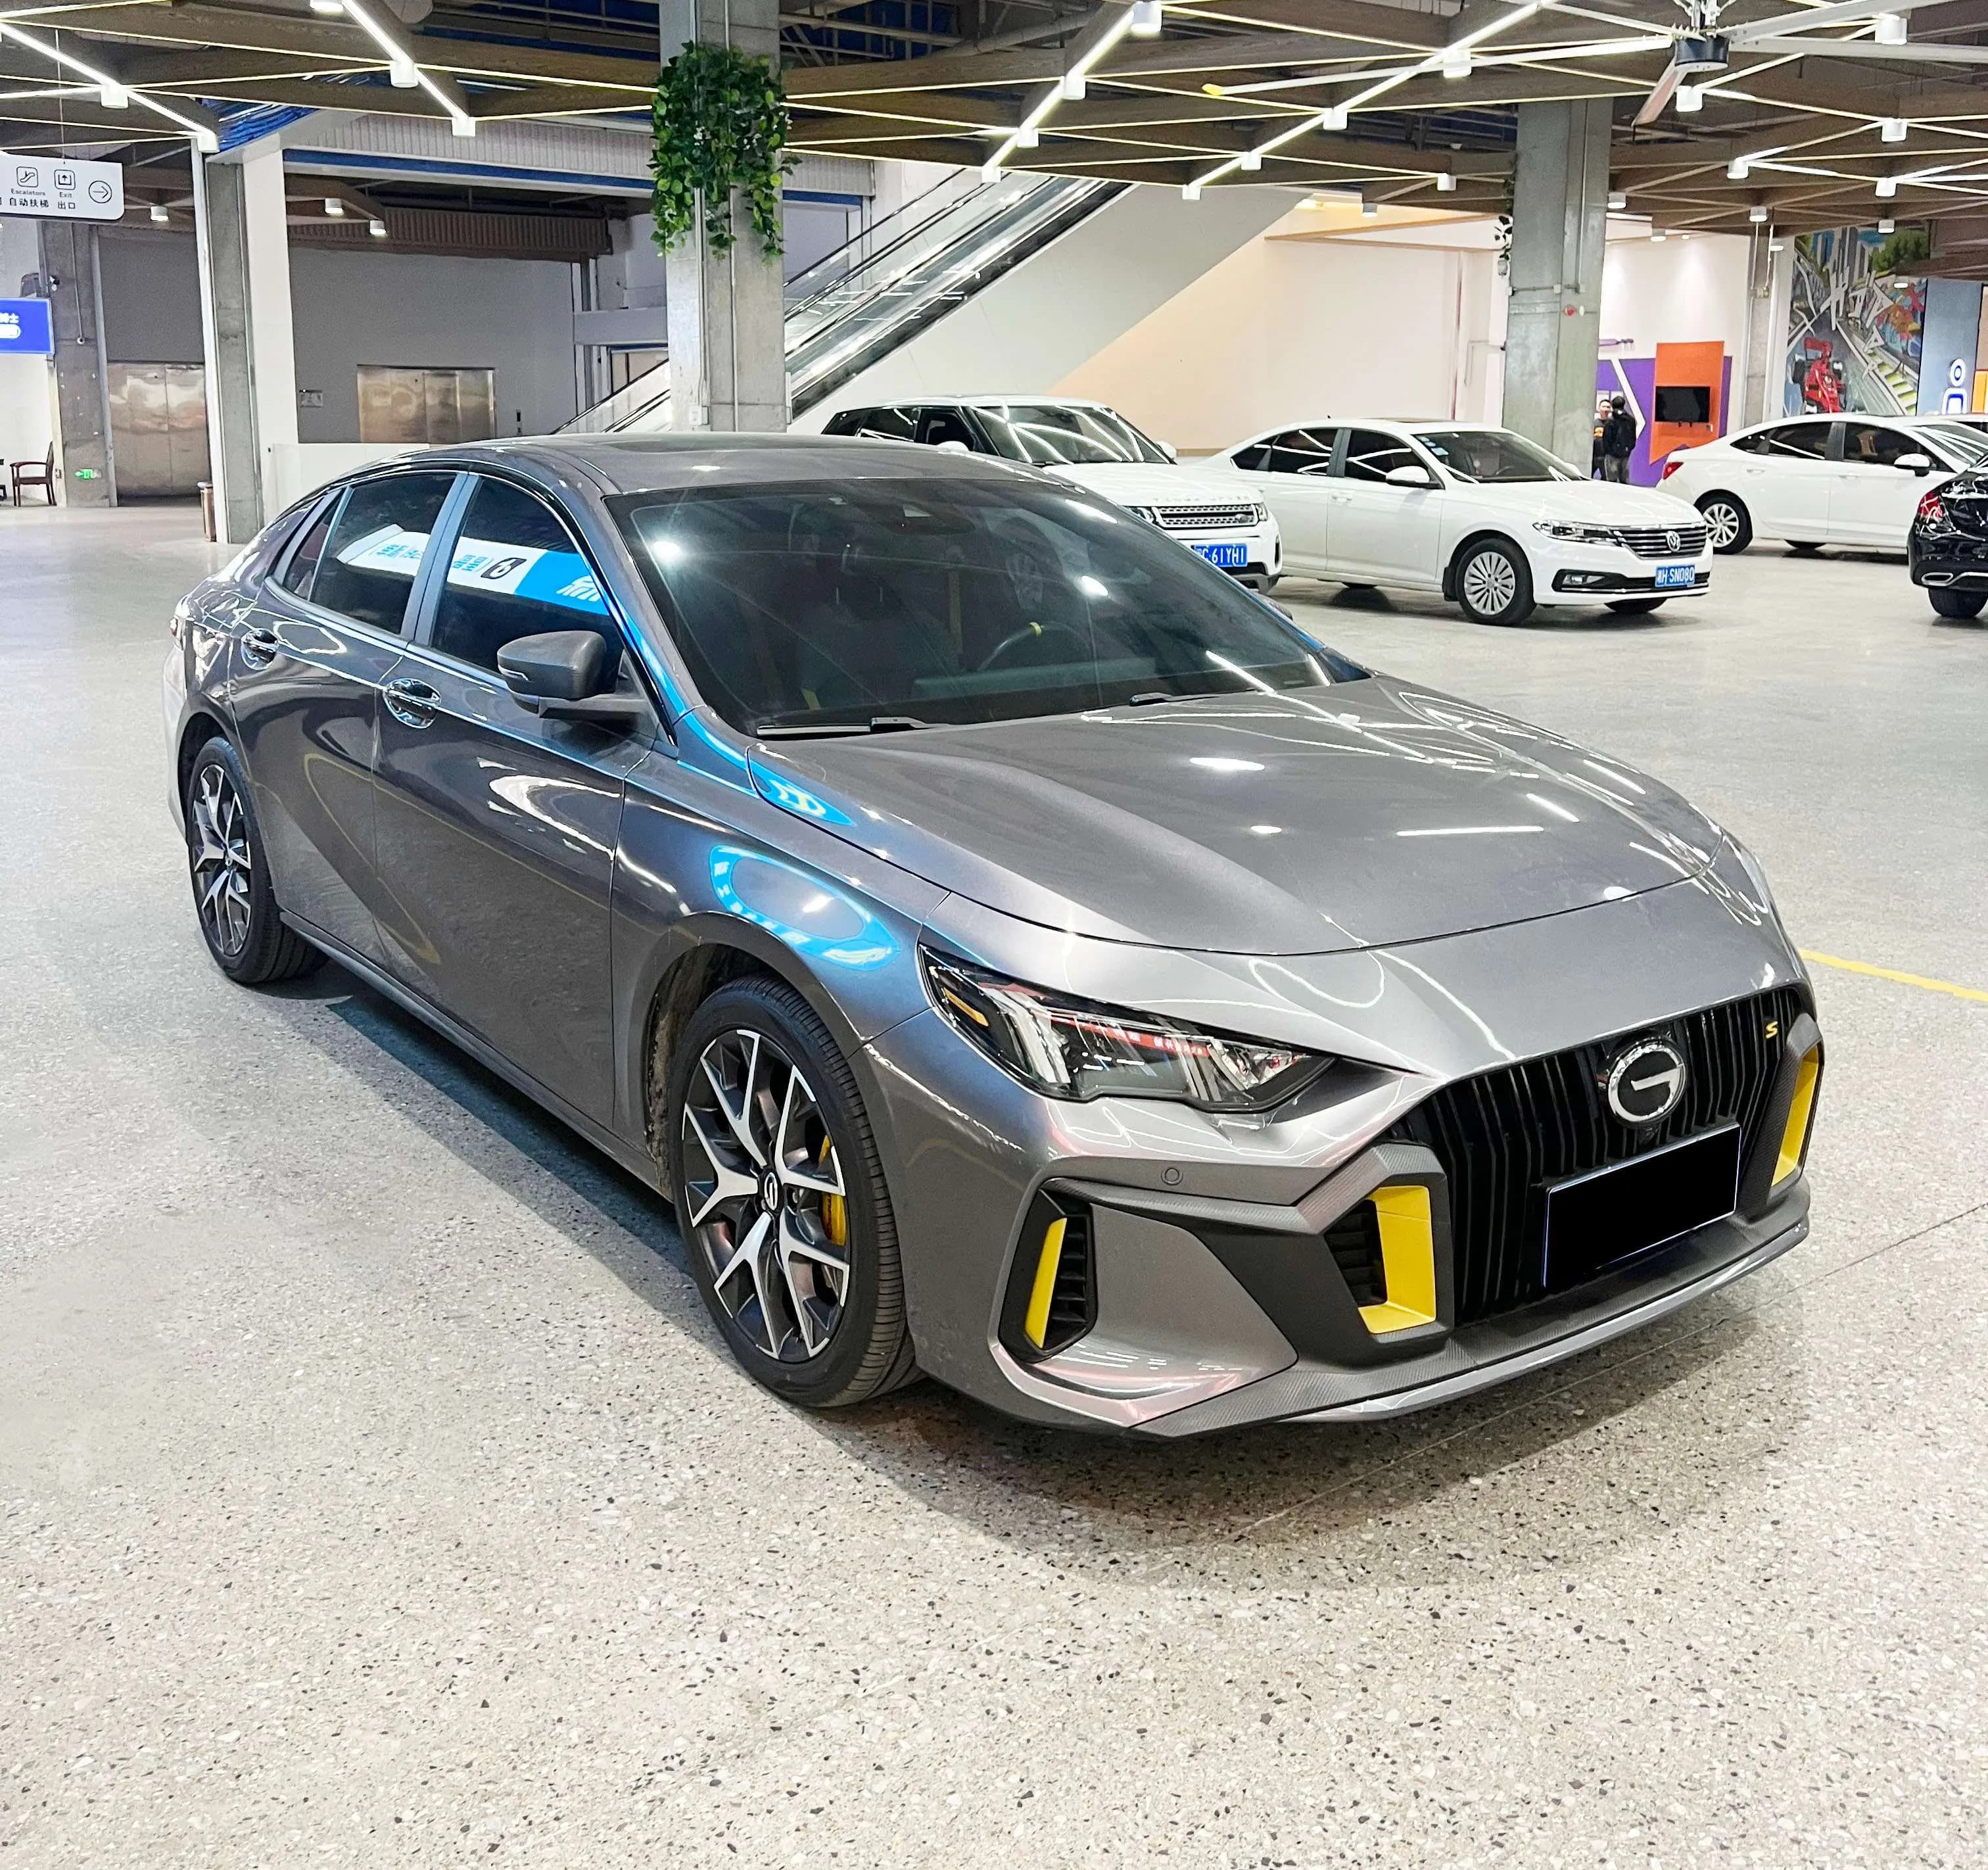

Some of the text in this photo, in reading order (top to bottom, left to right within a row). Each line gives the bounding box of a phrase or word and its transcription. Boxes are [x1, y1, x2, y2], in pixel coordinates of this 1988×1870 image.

[9, 197, 49, 207] 自动扶梯
[58, 201, 76, 209] 出口
[1766, 1020, 1778, 1039] S
